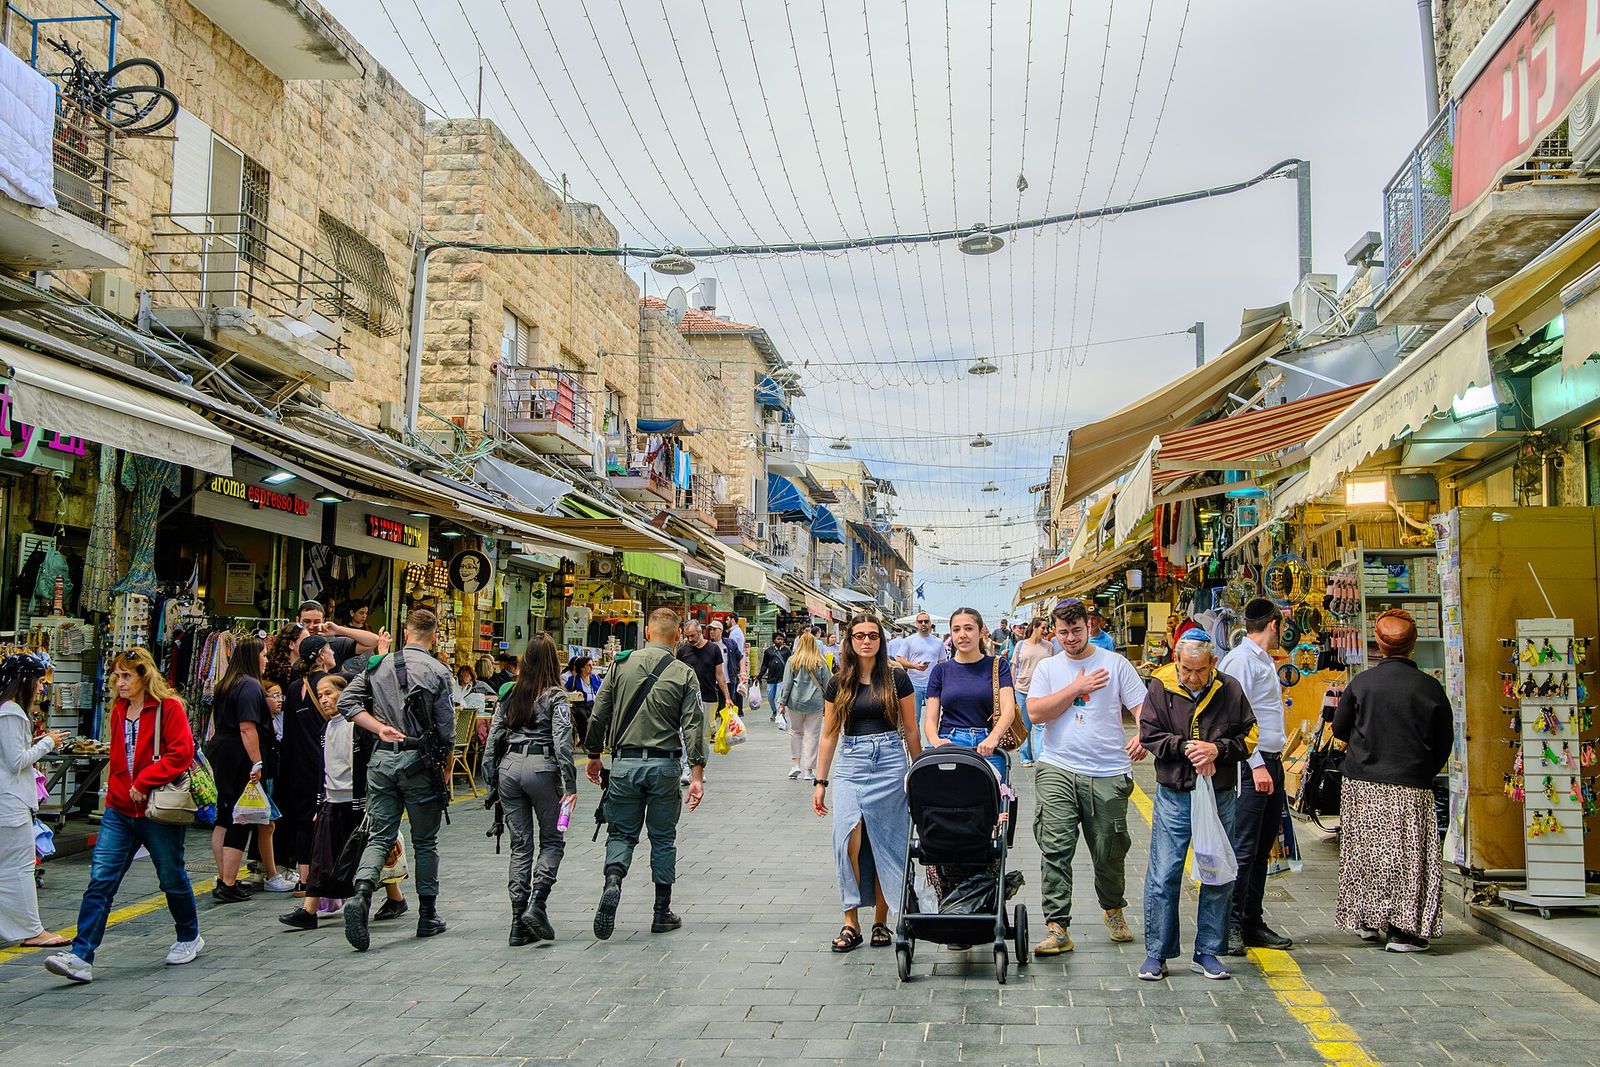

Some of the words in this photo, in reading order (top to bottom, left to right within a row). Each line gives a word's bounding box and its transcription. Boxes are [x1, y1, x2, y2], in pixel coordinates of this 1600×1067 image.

[211, 477, 246, 499] aroma
[248, 485, 292, 510] espresso
[293, 493, 309, 516] bar
